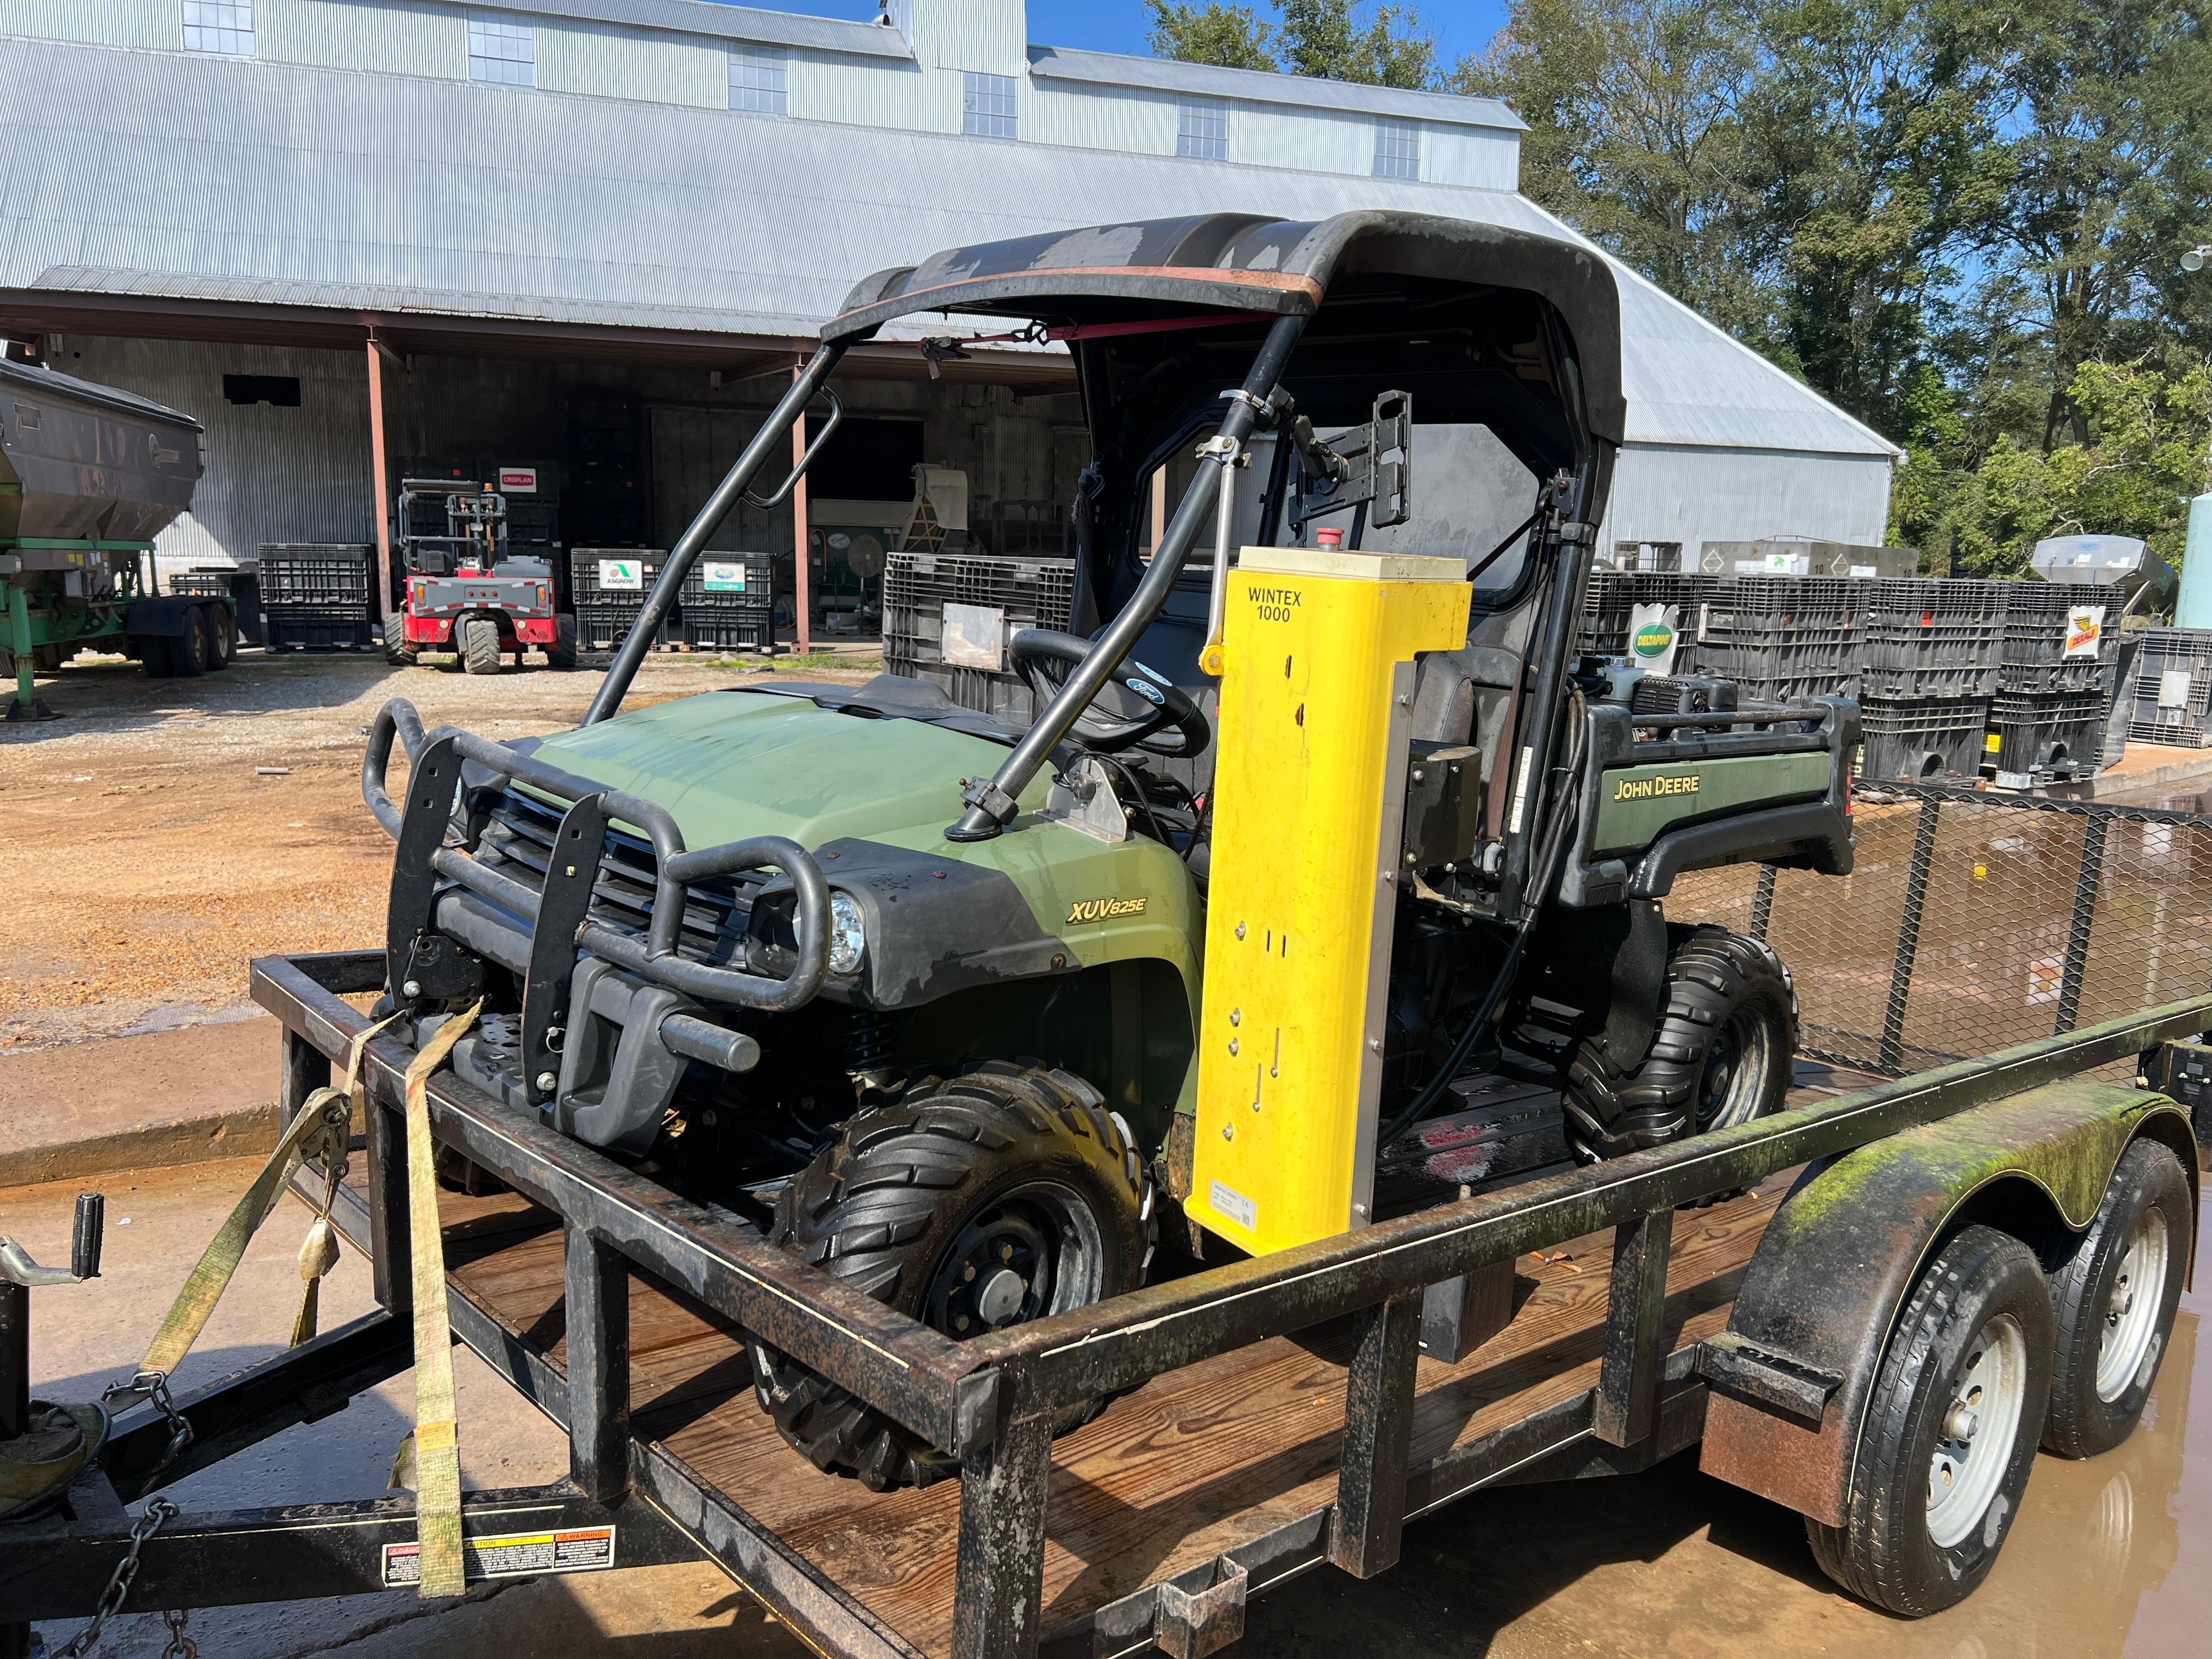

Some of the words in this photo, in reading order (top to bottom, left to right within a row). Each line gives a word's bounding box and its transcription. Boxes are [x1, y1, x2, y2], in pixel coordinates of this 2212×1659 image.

[1814, 564, 1824, 574] 10
[1248, 586, 1302, 607] WINTEX
[1256, 605, 1290, 622] 1000
[1637, 634, 1670, 646] DELTAPINE
[2072, 629, 2095, 647] DEKALB
[1133, 682, 1159, 701] Ford
[1613, 779, 1652, 800] JOHN
[1655, 775, 1700, 795] DEERE
[1065, 897, 1147, 924] XUV825E
